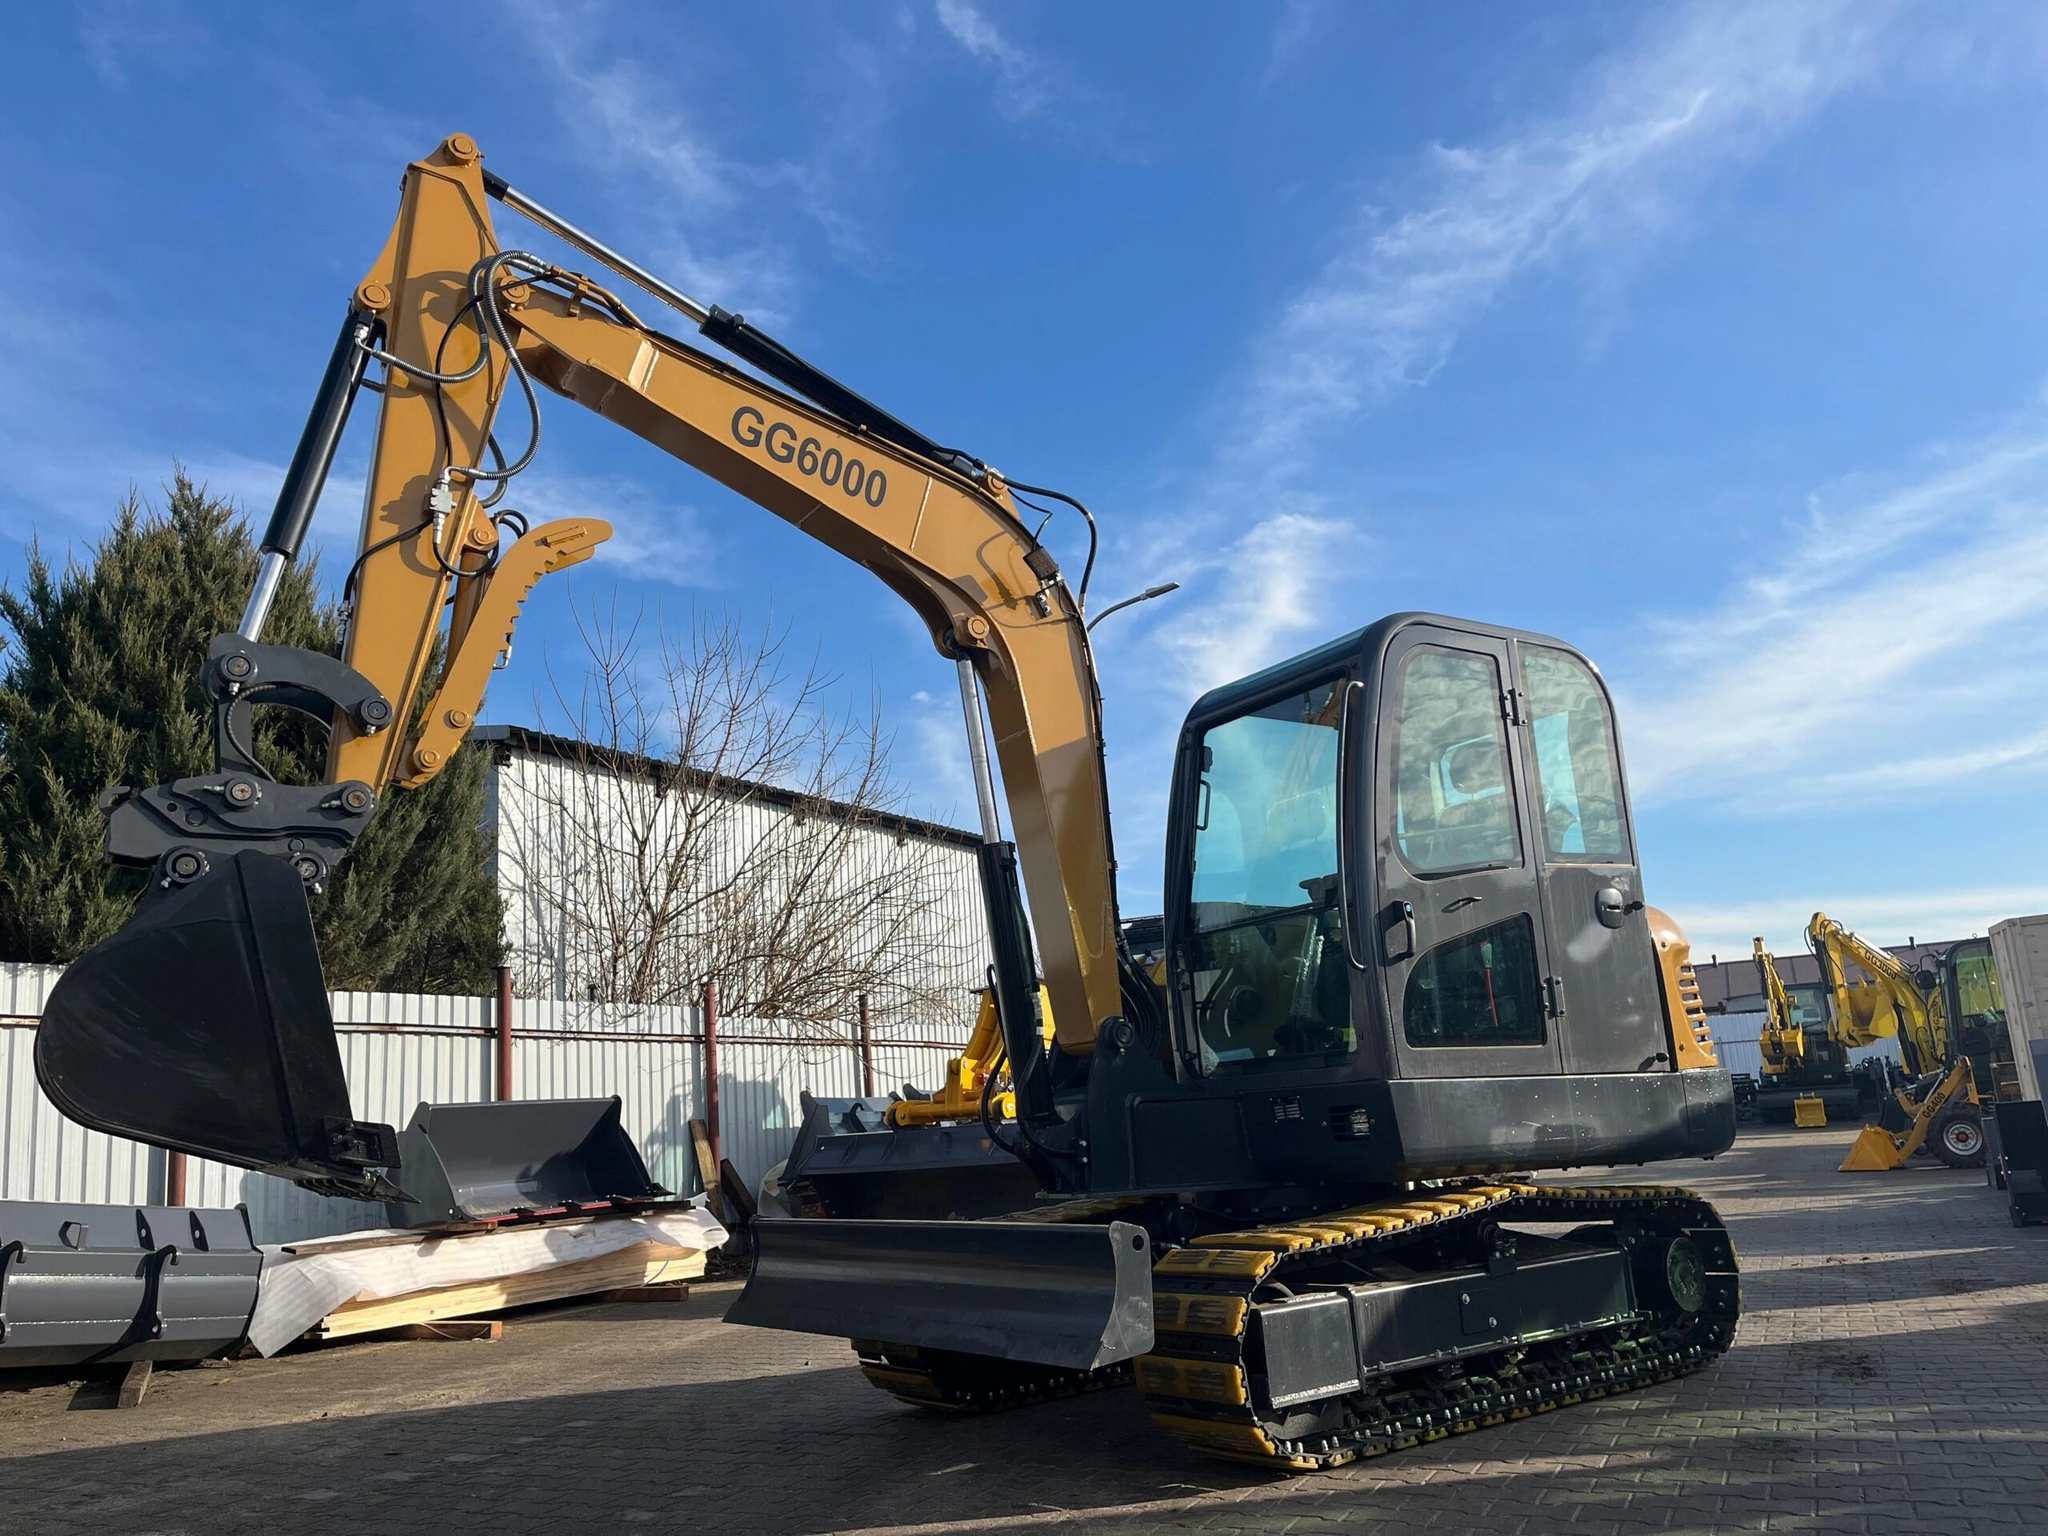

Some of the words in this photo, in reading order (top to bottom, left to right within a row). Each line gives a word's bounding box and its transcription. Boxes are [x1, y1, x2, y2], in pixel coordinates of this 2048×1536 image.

[731, 406, 887, 507] GG6000
[1865, 950, 1896, 980] GG3000
[1922, 1092, 1946, 1118] GG400
